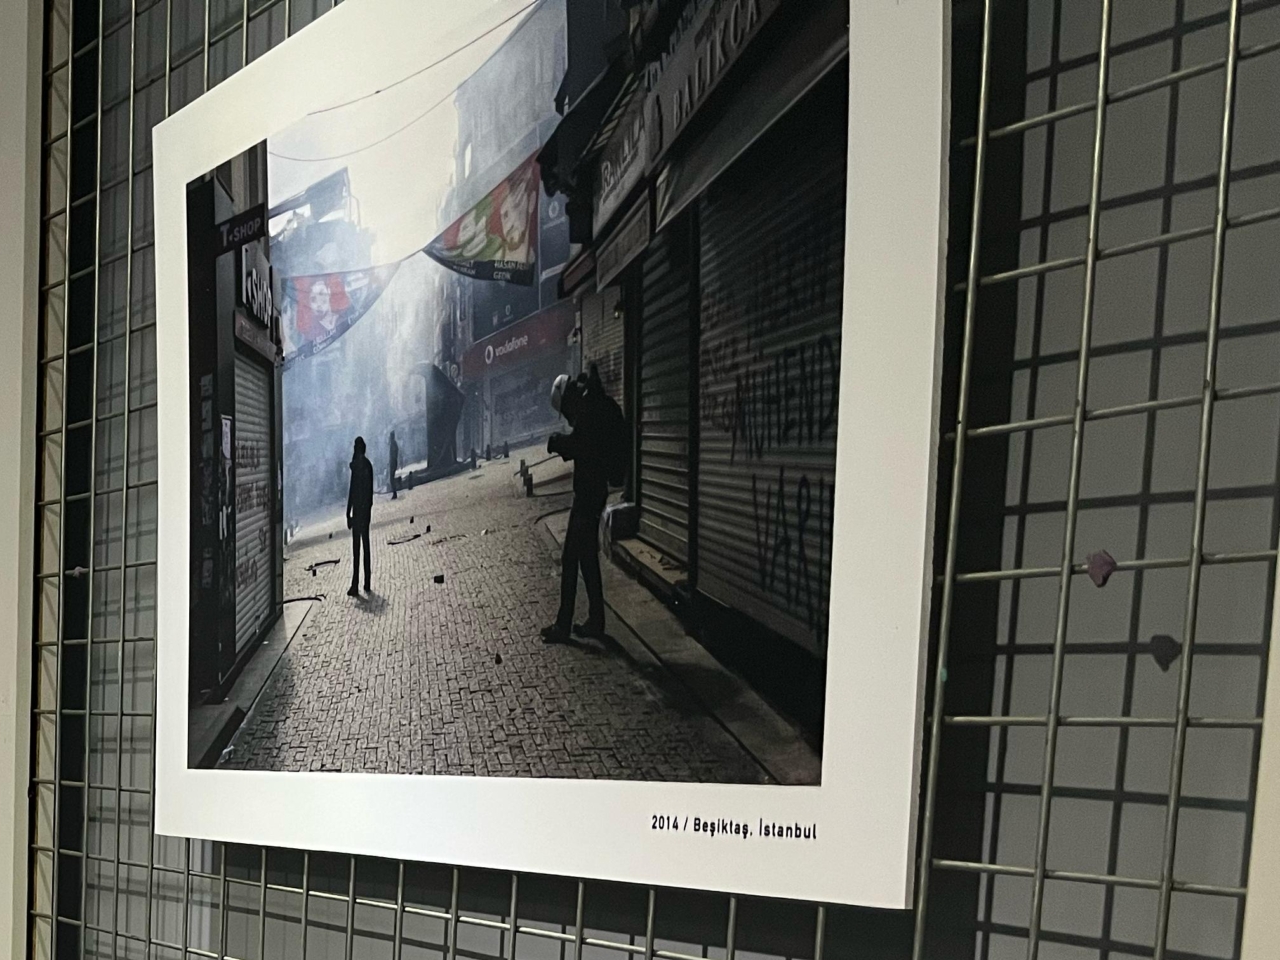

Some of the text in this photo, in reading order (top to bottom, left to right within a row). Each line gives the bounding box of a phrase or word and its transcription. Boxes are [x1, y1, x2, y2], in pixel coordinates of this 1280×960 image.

[495, 334, 528, 357] vodafone
[651, 815, 679, 831] 2014
[683, 816, 689, 832] /
[759, 817, 817, 840] İstanbul
